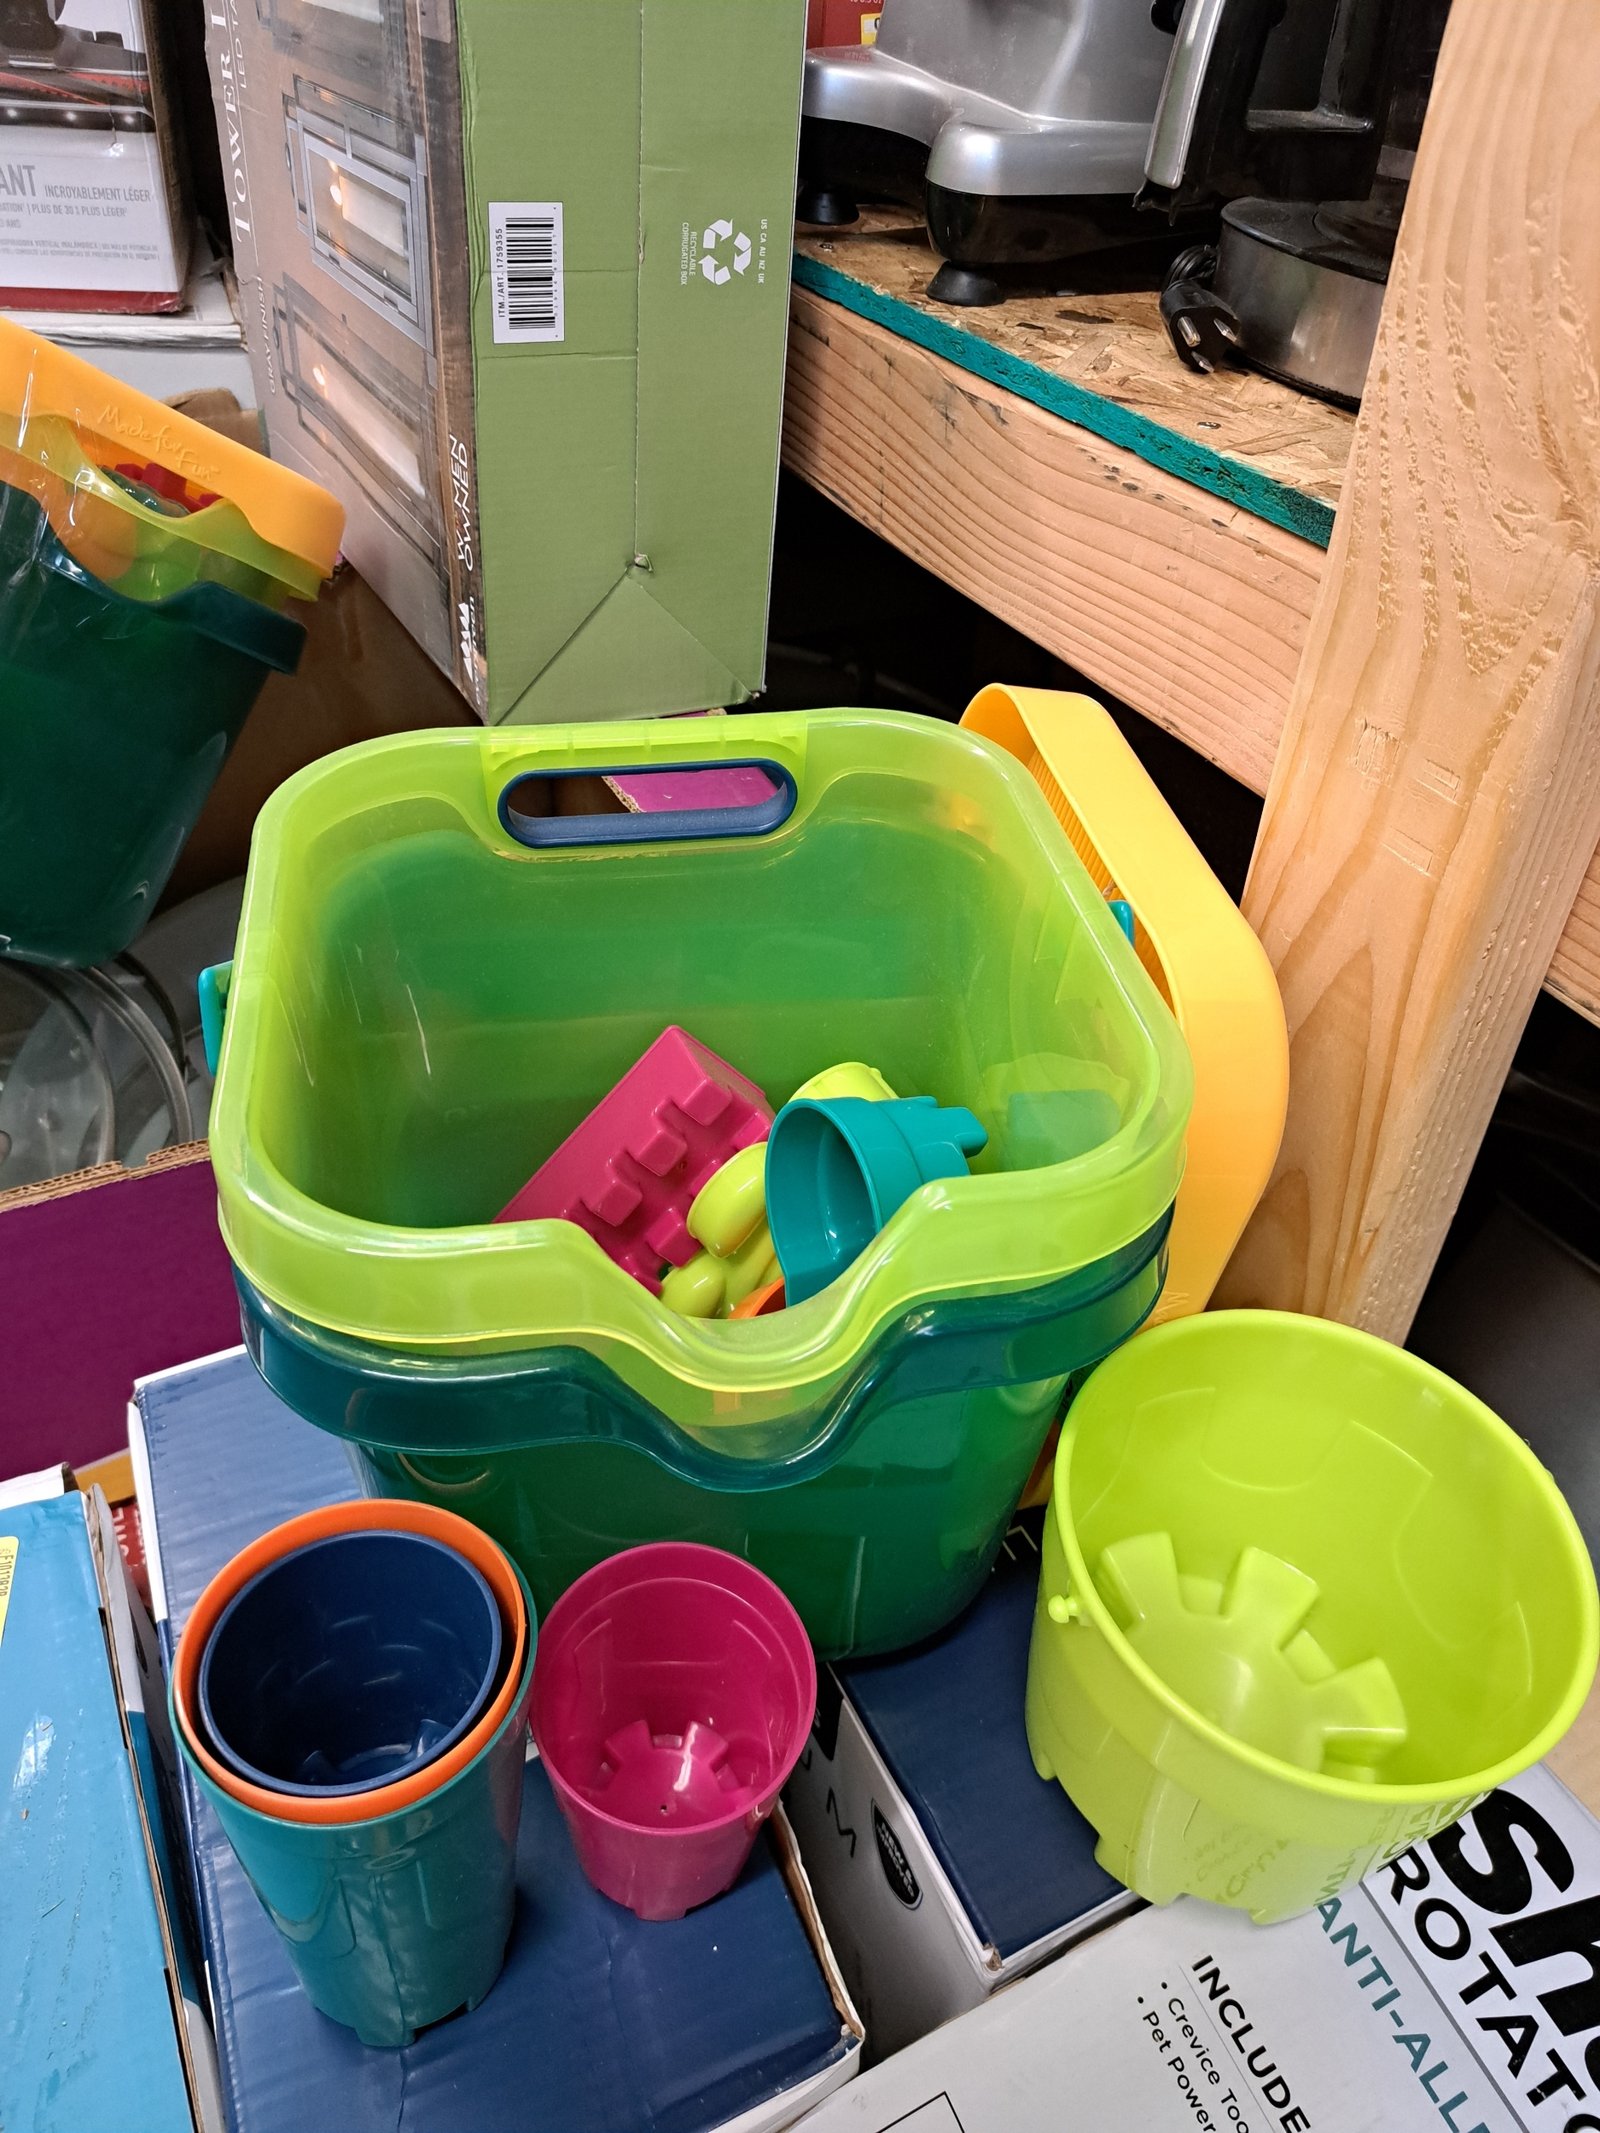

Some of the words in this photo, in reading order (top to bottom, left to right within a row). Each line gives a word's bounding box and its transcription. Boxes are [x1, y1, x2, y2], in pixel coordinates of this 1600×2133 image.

[235, 37, 247, 89] LED
[220, 50, 252, 243] TOWER
[31, 203, 51, 214] PLUS
[52, 204, 63, 215] DE
[81, 205, 101, 216] PLUS
[44, 184, 121, 201] INCROYABLEMENT
[122, 185, 152, 202] LÉGER
[681, 222, 690, 270] CORRUGATED
[759, 232, 768, 244] CA
[760, 218, 768, 230] US
[495, 228, 505, 268] 1759355
[688, 231, 698, 277] RECYCLABLE
[758, 259, 766, 271] NZ
[759, 245, 767, 257] AU
[496, 272, 506, 318] ITM./ART.
[680, 270, 688, 286] BOX
[757, 272, 766, 284] UK
[255, 274, 270, 341] FINISH
[264, 342, 276, 395] GRAY
[458, 442, 474, 572] OWNED
[1168, 1997, 1221, 2086] Crevice
[1142, 2010, 1172, 2053] Pet
[1167, 2056, 1217, 2132] Power
